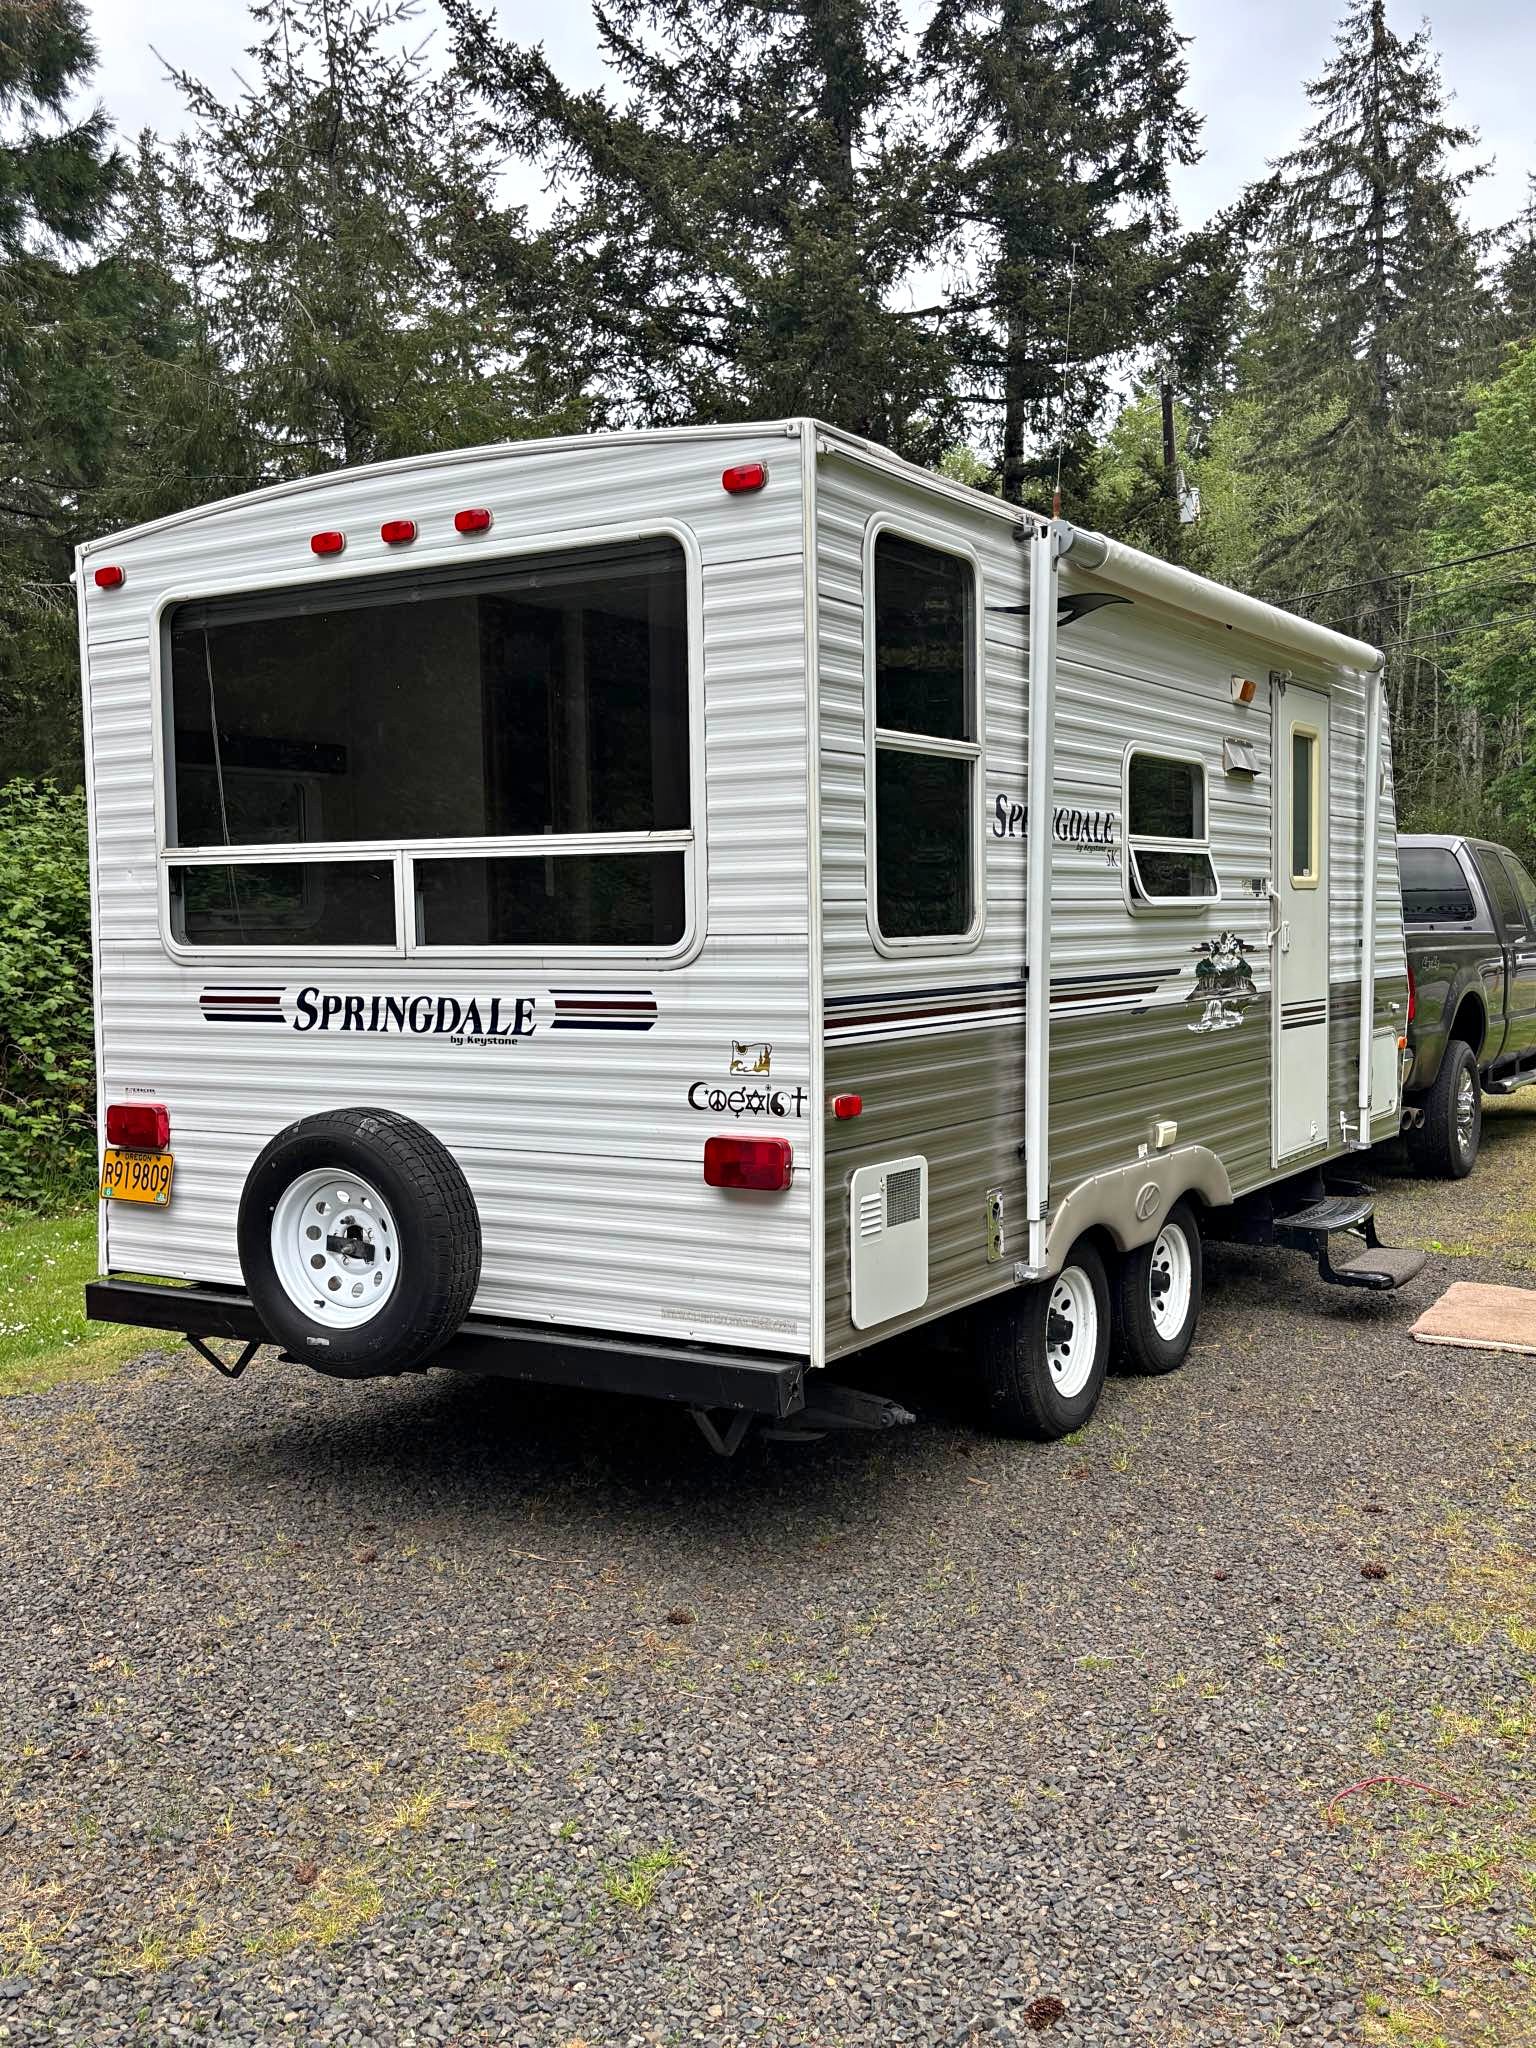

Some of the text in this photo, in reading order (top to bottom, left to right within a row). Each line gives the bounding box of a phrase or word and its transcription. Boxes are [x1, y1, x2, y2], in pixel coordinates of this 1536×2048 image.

[293, 987, 537, 1036] SPRINGDALE
[450, 1035, 518, 1046] by Keystone
[125, 1152, 152, 1162] OREGON
[105, 1161, 169, 1192] R919809
